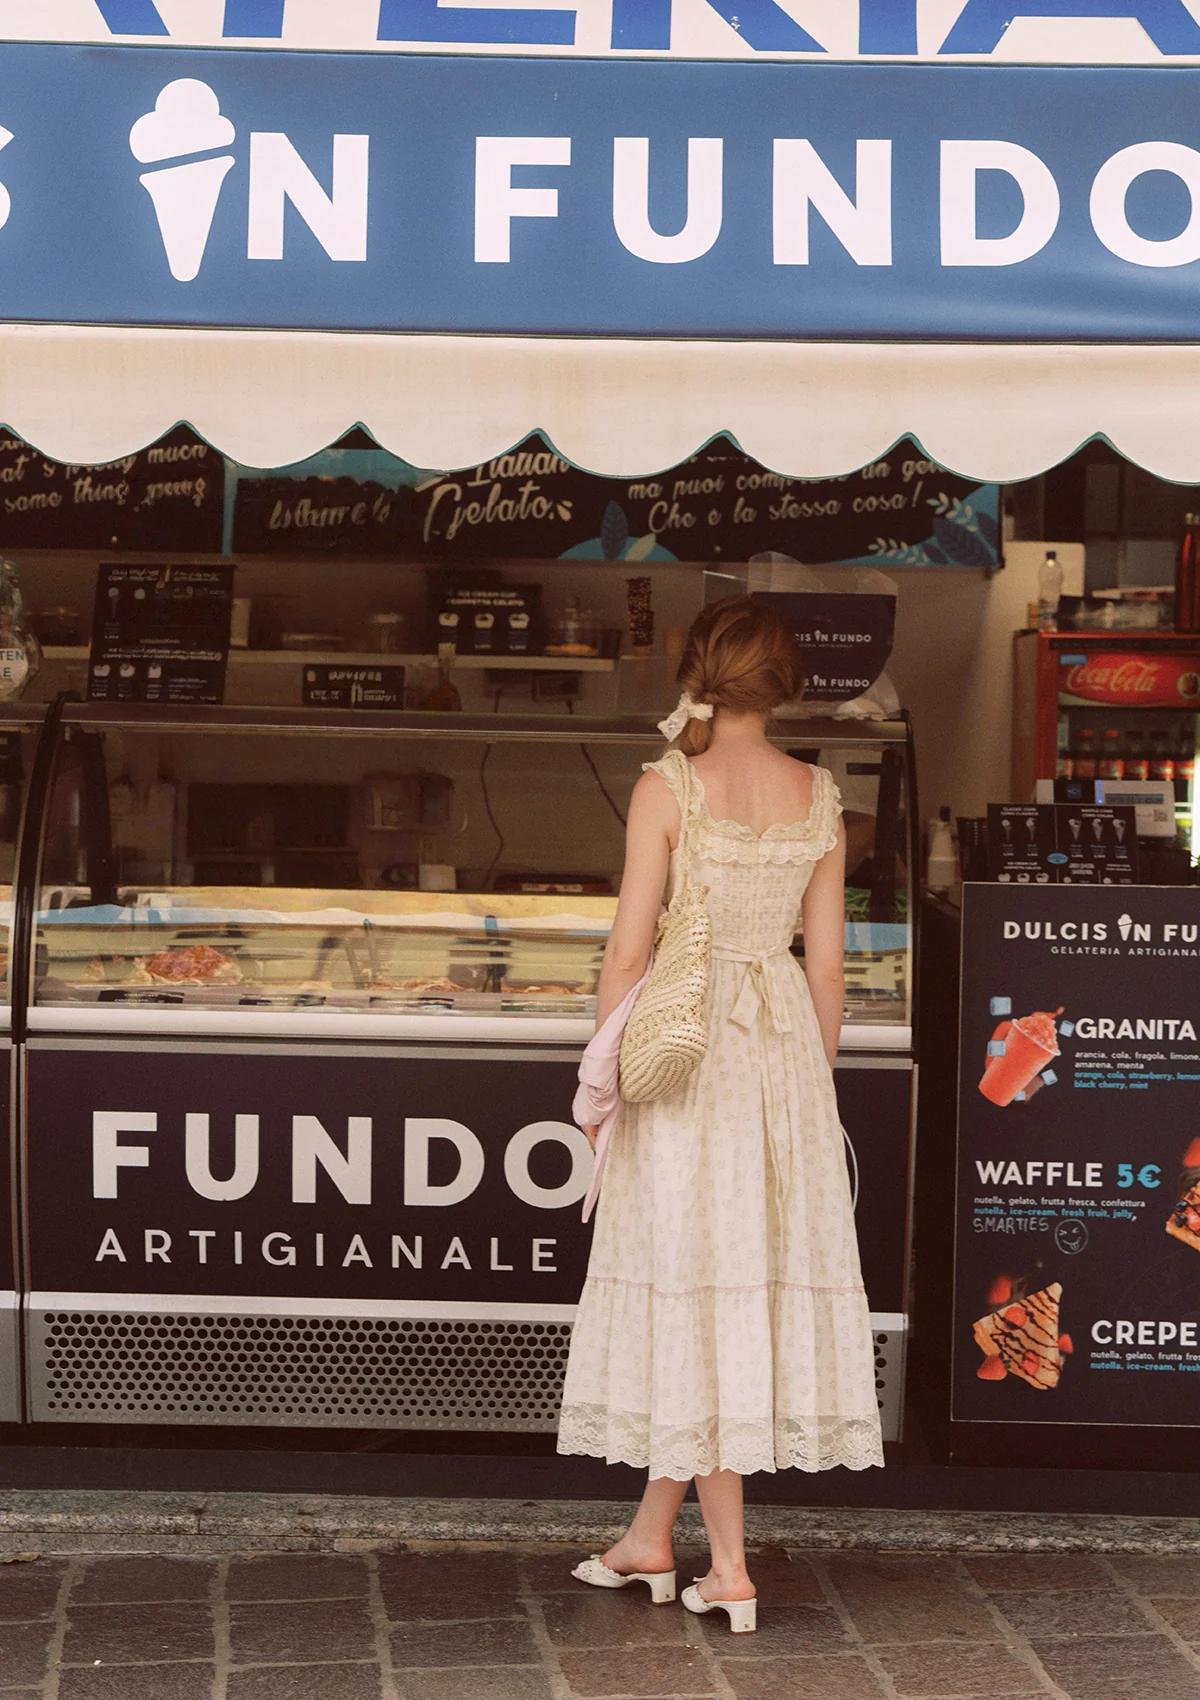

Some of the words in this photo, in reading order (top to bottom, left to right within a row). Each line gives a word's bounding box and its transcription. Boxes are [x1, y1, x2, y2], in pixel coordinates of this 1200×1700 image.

[474, 137, 1200, 267] FUNDO
[648, 501, 697, 533] Che
[733, 496, 757, 523] la
[769, 493, 841, 520] stessa
[832, 633, 872, 643] FUNDO
[830, 679, 870, 688] FUNDO
[1003, 921, 1108, 941] DULCIS
[1051, 946, 1121, 955] GELATERIA
[1075, 1018, 1197, 1041] GRANITA
[1117, 1062, 1145, 1070] menta
[1074, 1080, 1096, 1088] black
[1129, 1082, 1149, 1090] mint
[93, 1111, 596, 1209] FUNDO
[975, 1160, 1103, 1187] WAFFLE
[1117, 1163, 1161, 1188] 5€
[1041, 1197, 1065, 1206] frutta
[1101, 1199, 1145, 1208] confettura
[1061, 1208, 1084, 1217] fresh
[973, 1217, 1049, 1235] SMARTIES
[95, 1228, 558, 1273] ARTIGIANALE
[1091, 1320, 1198, 1346] CREPE
[1158, 1352, 1182, 1361] frutta
